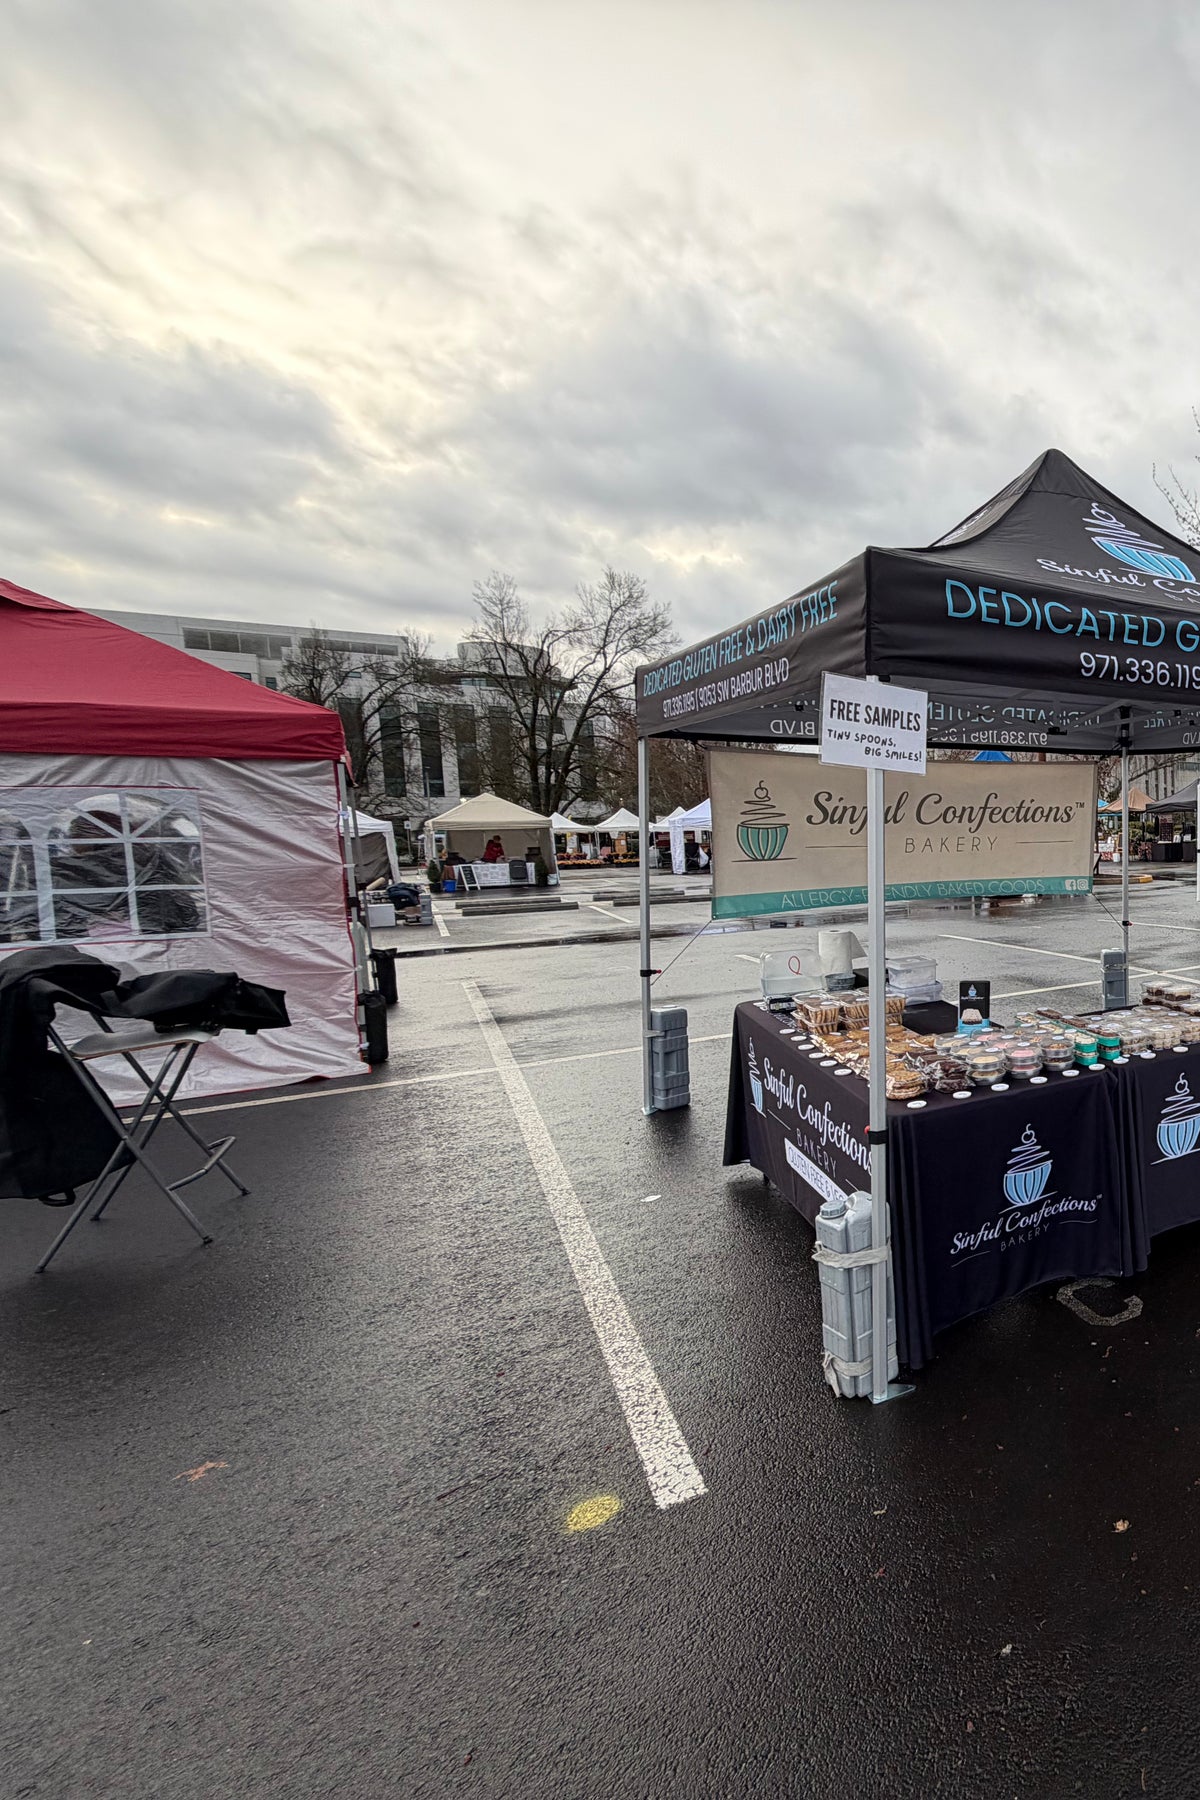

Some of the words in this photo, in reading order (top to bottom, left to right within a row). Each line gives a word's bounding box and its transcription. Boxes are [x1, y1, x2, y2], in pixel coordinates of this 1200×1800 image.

[1037, 558, 1146, 588] Sinful
[945, 578, 1166, 647] DEDICATED
[643, 660, 683, 697] DEDICATED
[683, 641, 717, 681] GLUTEN
[718, 628, 744, 667] FREE
[745, 624, 755, 657] &
[757, 602, 797, 652] DAIRY
[800, 579, 839, 633] FREE
[662, 689, 695, 719] 971.336.1195
[699, 682, 717, 709] 9053
[717, 679, 730, 703] SW
[730, 670, 764, 699] BARBUR
[764, 657, 790, 685] BLVD
[829, 698, 861, 723] FREE
[863, 704, 921, 732] SAMPLES
[827, 728, 851, 741] TINY
[854, 732, 897, 748] SPOONS,
[864, 746, 882, 757] BIG
[884, 749, 923, 762] SMILES!
[904, 836, 999, 854] BAKERY
[936, 881, 986, 897] BAKED
[987, 878, 1045, 896] GOODS
[763, 1057, 795, 1110] Sinful
[796, 1128, 838, 1180] BAKERY
[950, 1217, 1003, 1255] Sinful
[1000, 1222, 1051, 1252] BAKERY
